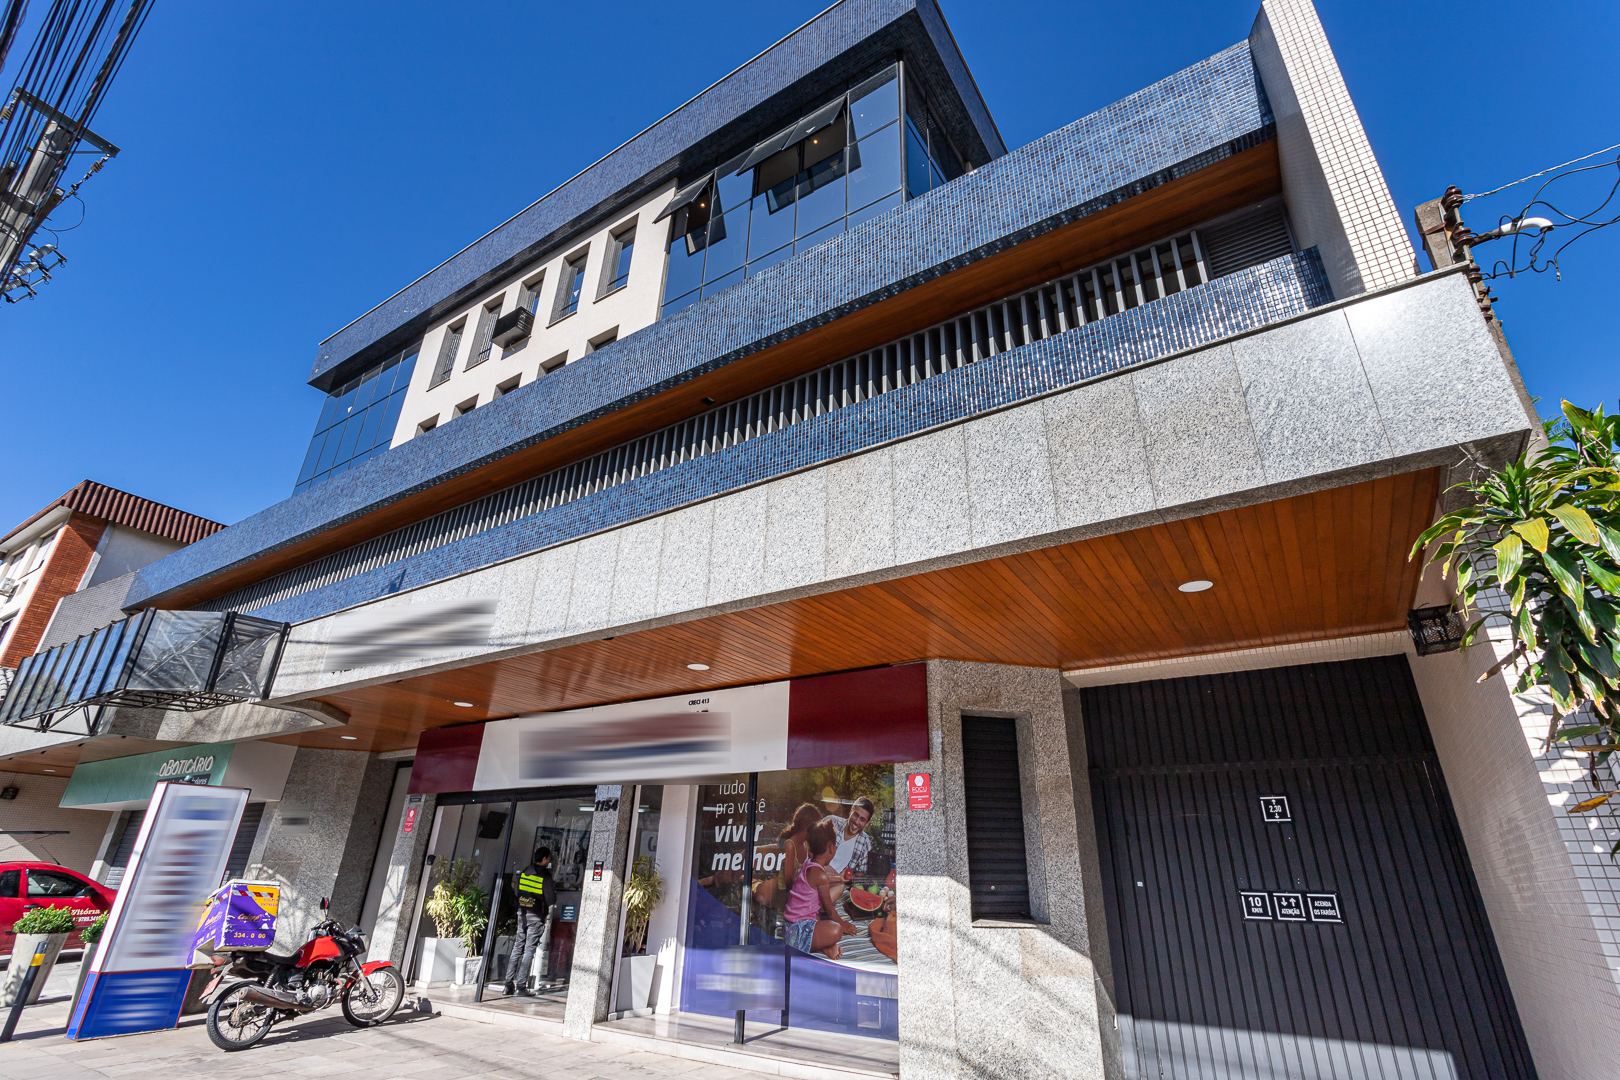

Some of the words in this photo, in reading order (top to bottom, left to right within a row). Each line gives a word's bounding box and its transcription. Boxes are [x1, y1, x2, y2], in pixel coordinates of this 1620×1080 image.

[594, 798, 618, 811] 1154
[716, 802, 734, 818] pra
[1269, 804, 1282, 813] 2.30
[711, 846, 786, 870] mehor
[1248, 896, 1262, 906] 10
